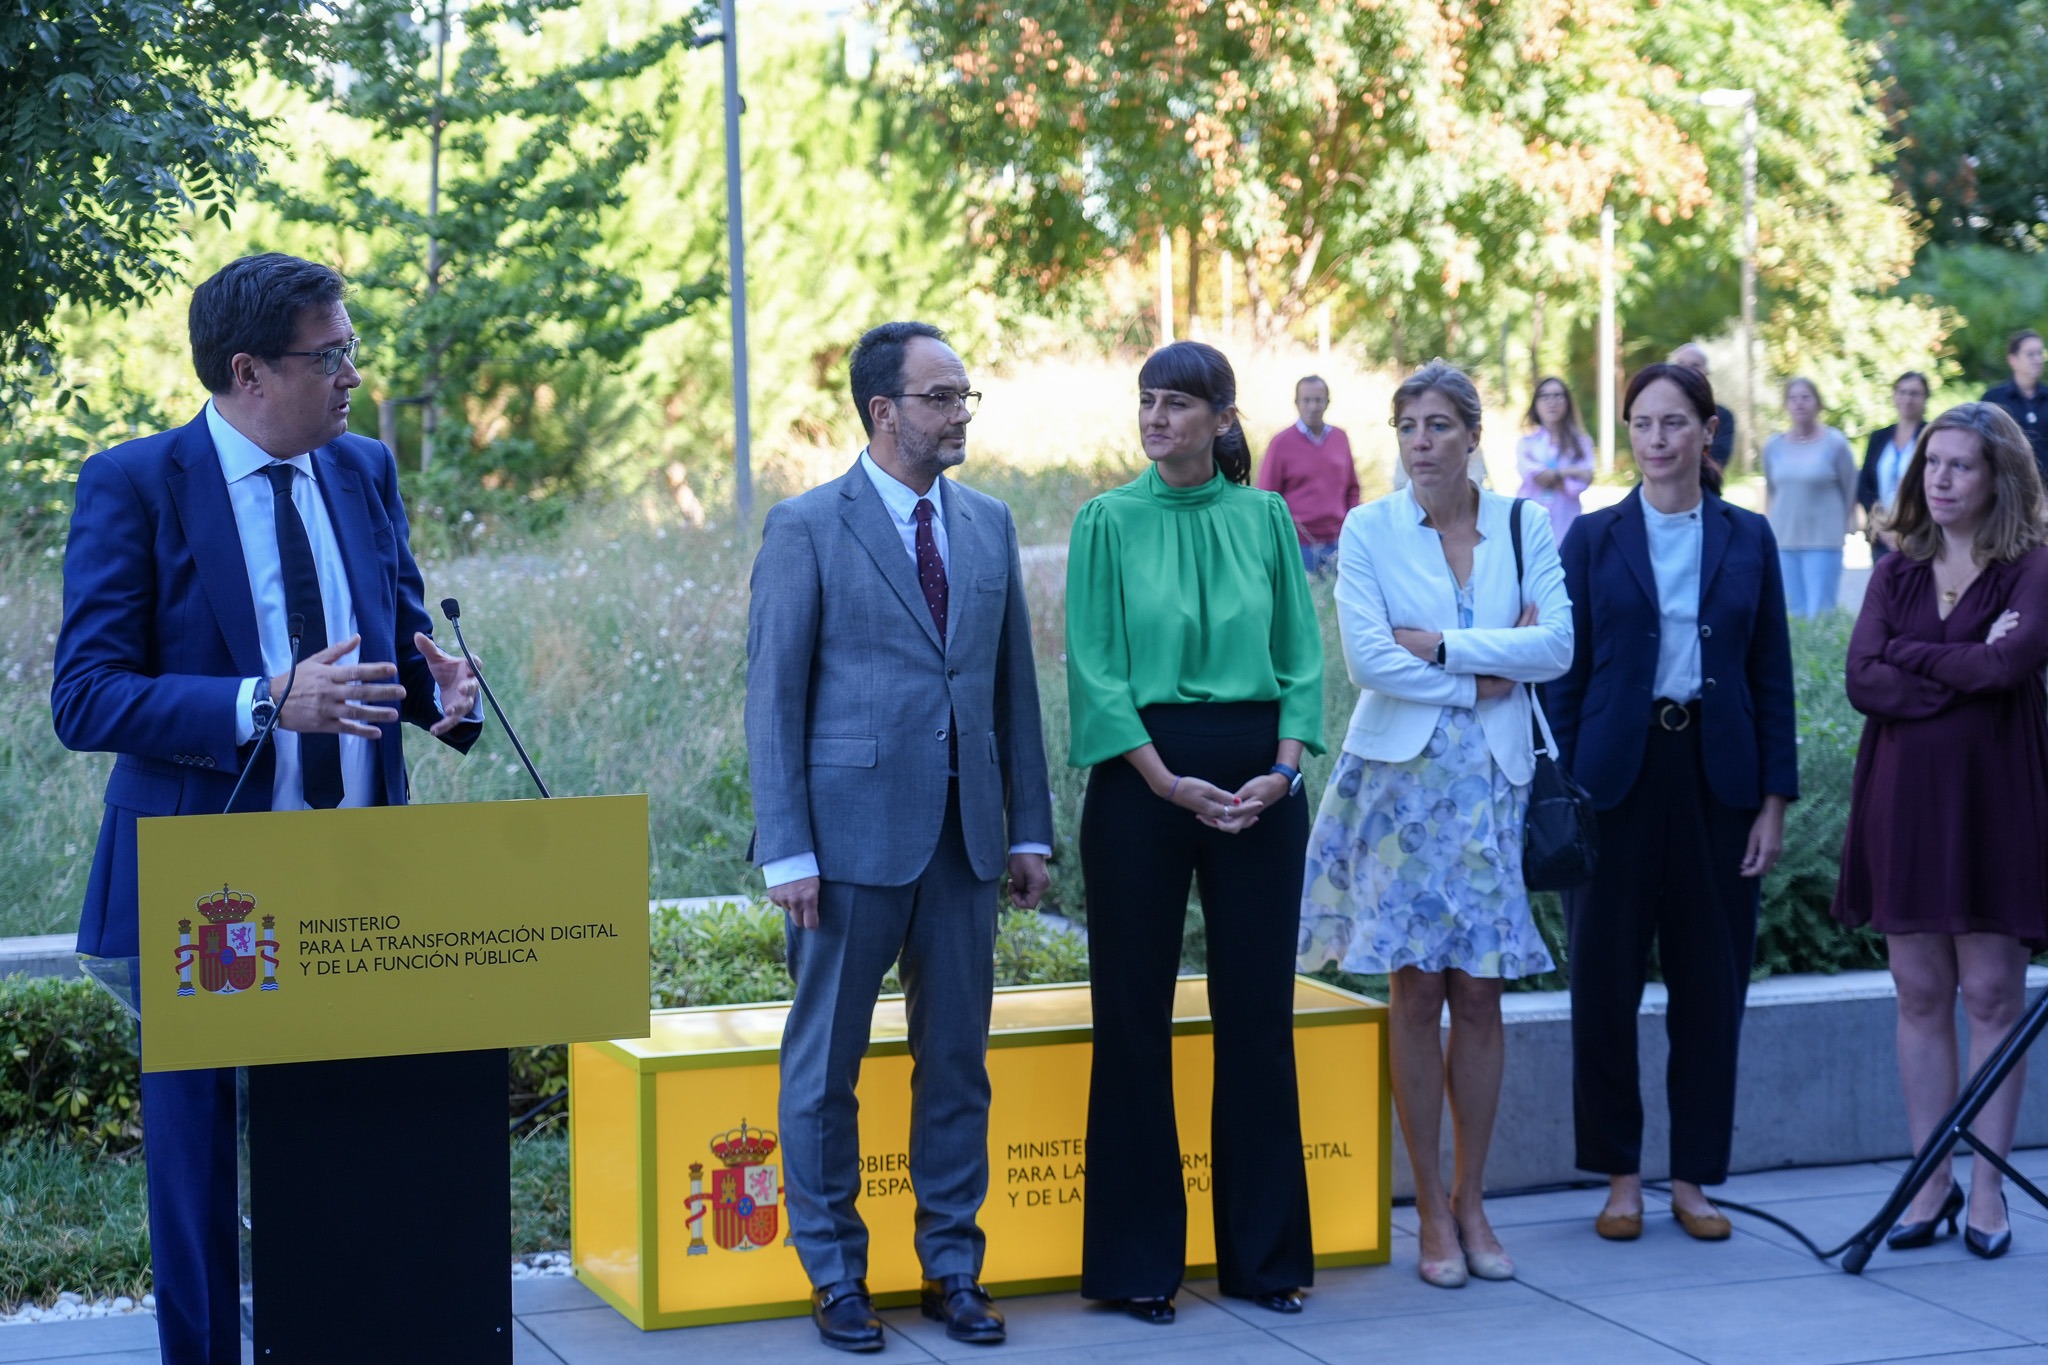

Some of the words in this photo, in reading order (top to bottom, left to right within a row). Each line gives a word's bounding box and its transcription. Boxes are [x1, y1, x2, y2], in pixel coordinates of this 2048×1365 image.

[299, 915, 401, 935] MINISTERIO
[299, 939, 346, 955] PARA
[351, 937, 373, 953] LA
[375, 924, 545, 951] TRANSFORMACIÓN
[551, 923, 618, 941] DIGITAL
[299, 961, 311, 976] Y
[317, 959, 341, 975] DE
[346, 958, 369, 973] LA
[374, 949, 459, 972] FUNCIÓN
[465, 947, 538, 966] PÚBLICA
[1007, 1138, 1084, 1160] MINISTE
[858, 1153, 910, 1173] BIER
[1007, 1165, 1057, 1184] PARA
[1063, 1162, 1086, 1180] LA
[1302, 1141, 1352, 1161] GITAL
[867, 1176, 913, 1198] ESPA
[1007, 1191, 1019, 1208] Y
[1026, 1188, 1052, 1207] DE
[1058, 1186, 1082, 1204] LA
